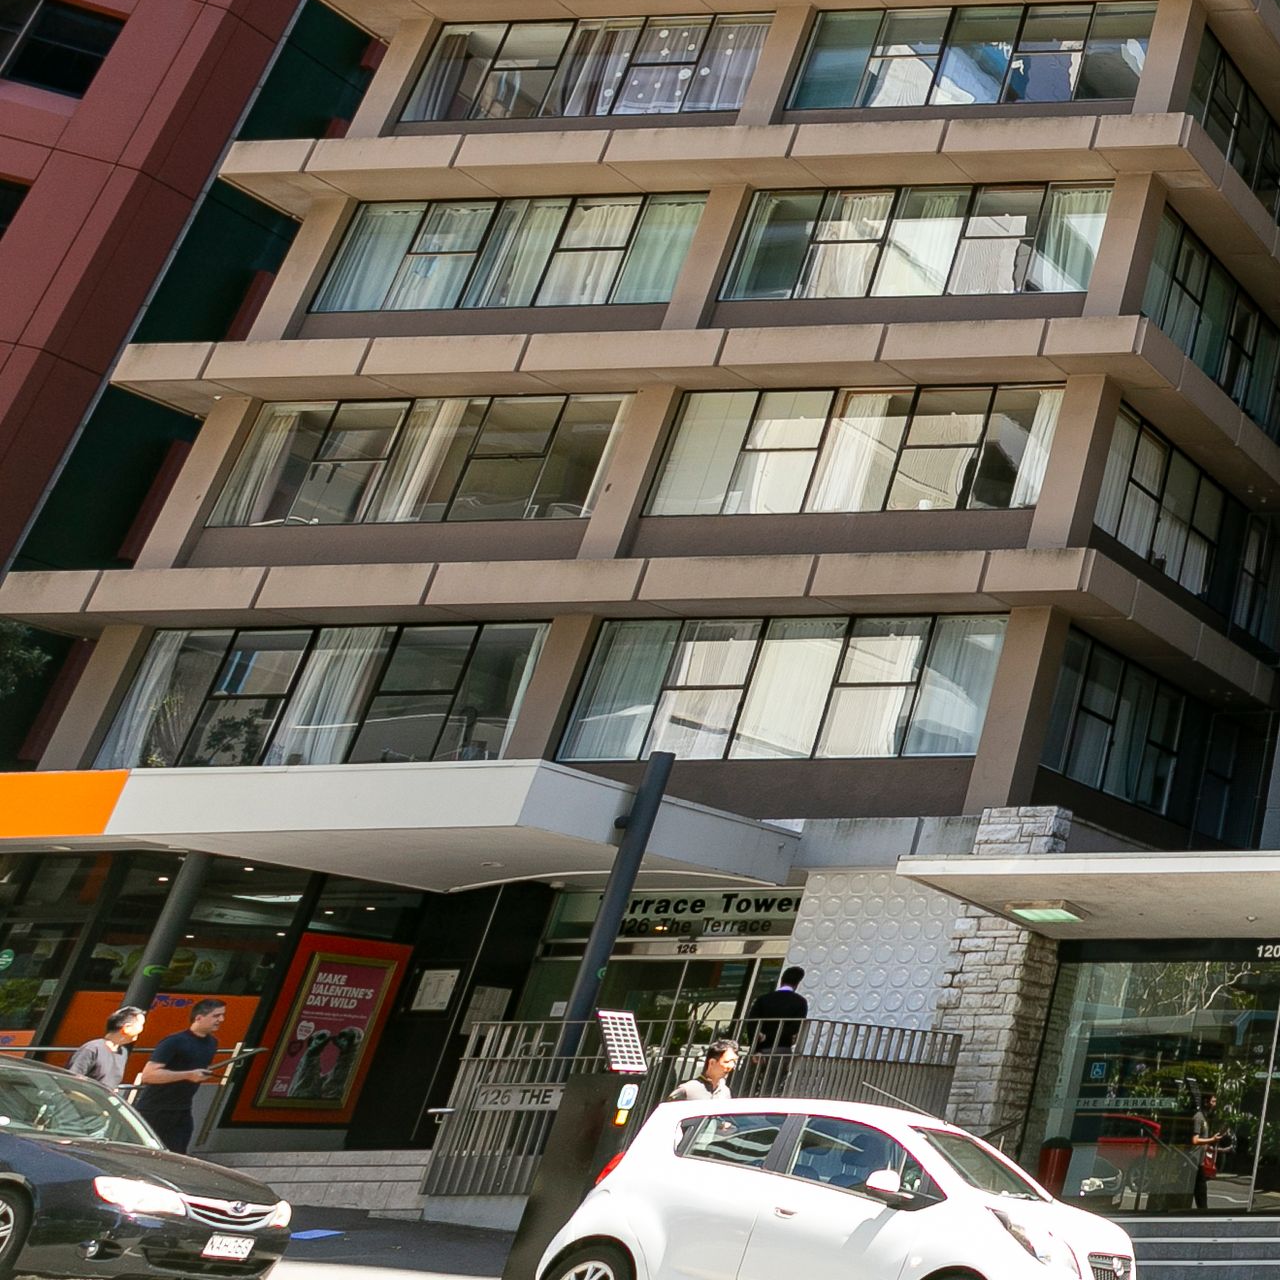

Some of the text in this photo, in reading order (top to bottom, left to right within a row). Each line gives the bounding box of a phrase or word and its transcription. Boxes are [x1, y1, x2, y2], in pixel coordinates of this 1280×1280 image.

[600, 895, 705, 914] rrace
[619, 917, 772, 935] 126 The Terrace
[677, 943, 697, 954] 126
[316, 972, 347, 985] MAKE
[311, 983, 375, 1000] VALENTINE'S
[306, 995, 358, 1009] DAY WILD
[481, 1089, 553, 1105] 126 THE
